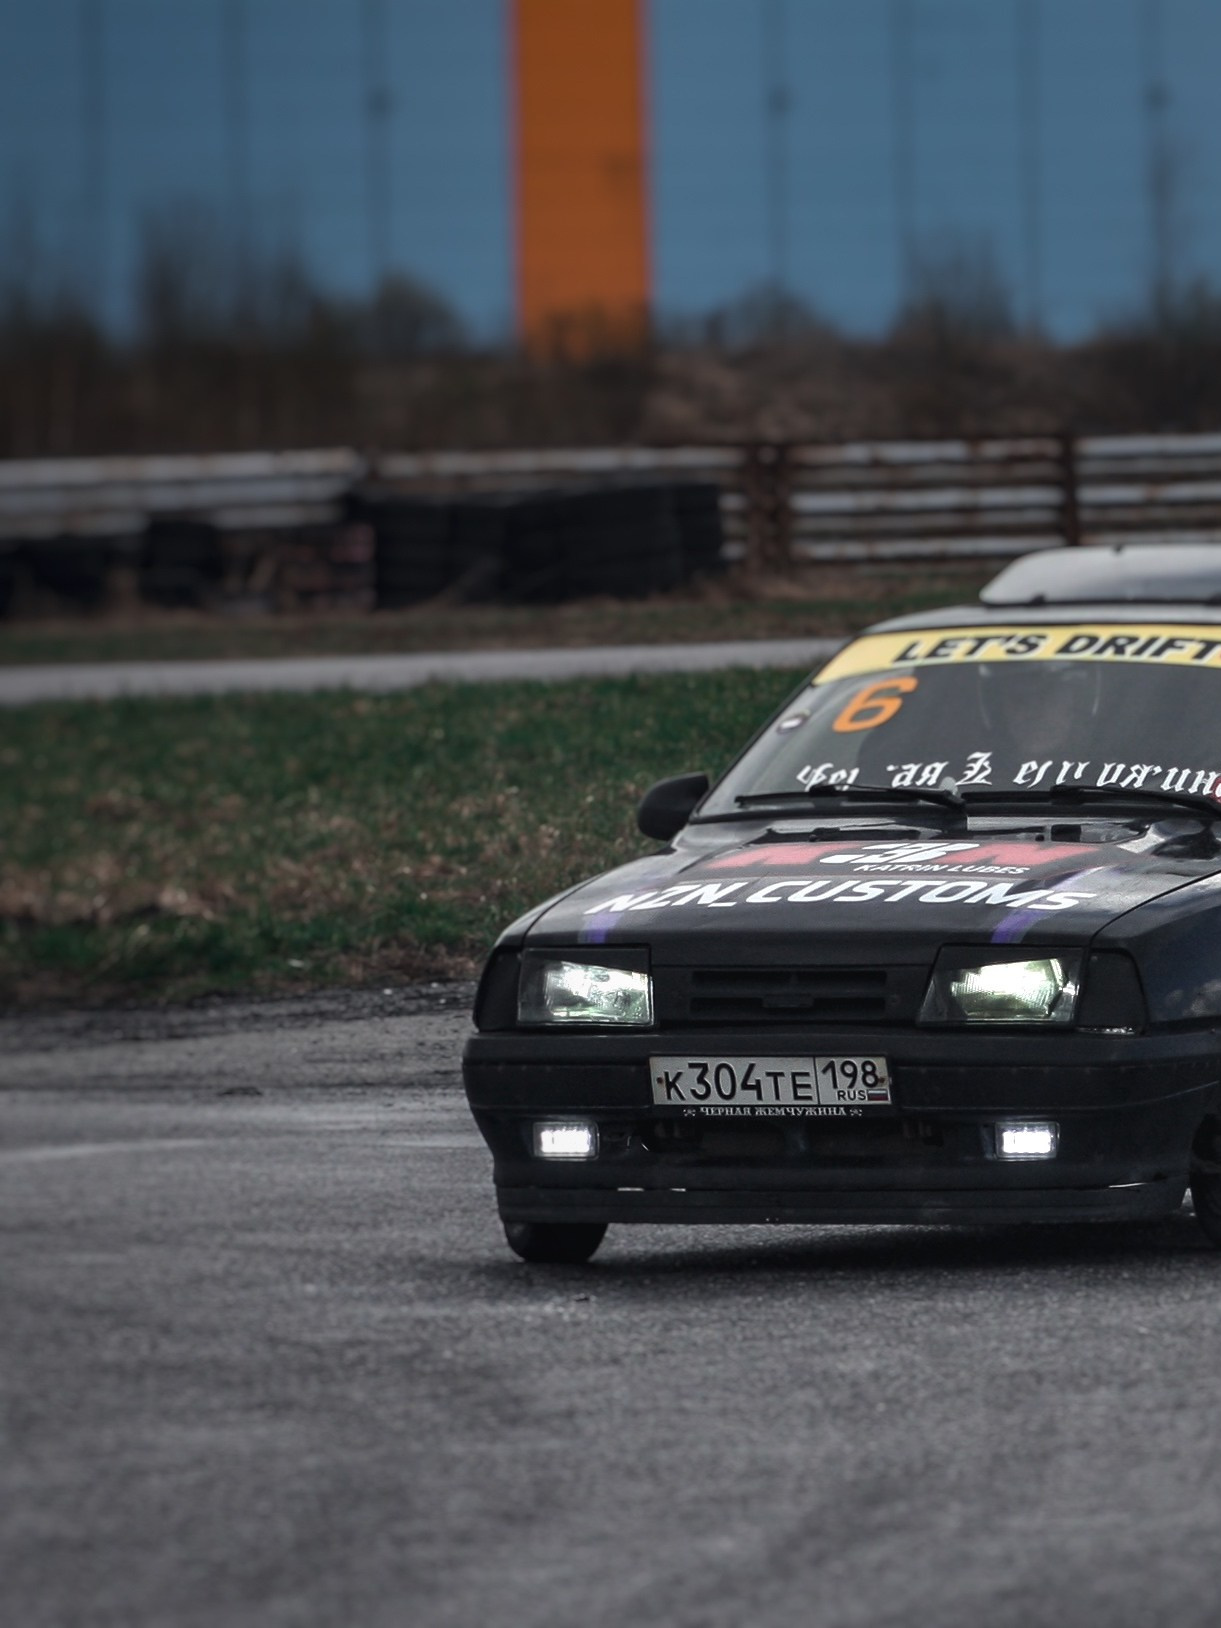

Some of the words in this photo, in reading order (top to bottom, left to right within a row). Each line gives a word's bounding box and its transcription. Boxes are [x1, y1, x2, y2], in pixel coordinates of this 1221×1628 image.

[892, 634, 1046, 664] LET'S
[832, 676, 918, 733] 6
[853, 864, 949, 873] KATRIN
[948, 865, 1031, 875] LUBES
[821, 1060, 879, 1089] 198
[837, 1089, 866, 1101] RUS
[700, 1107, 751, 1117] ЧЕРНАЯ
[754, 1107, 847, 1117] ЖЕМЧУЖИНА
